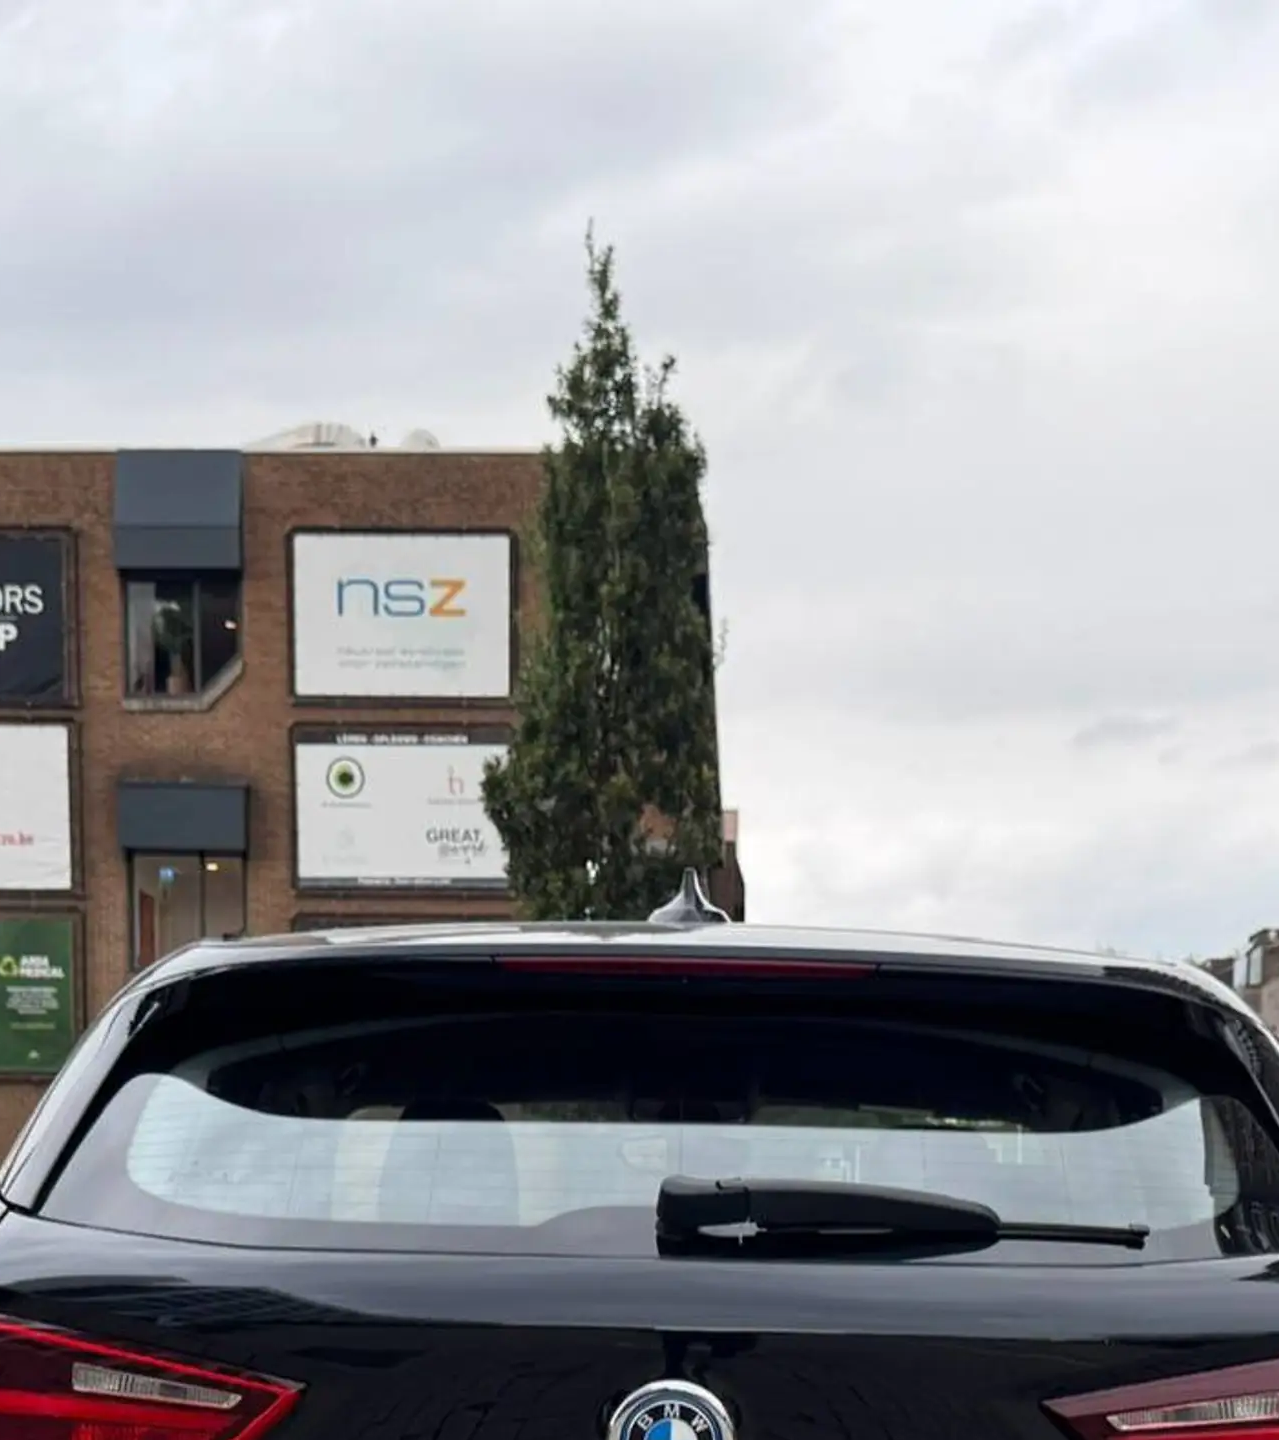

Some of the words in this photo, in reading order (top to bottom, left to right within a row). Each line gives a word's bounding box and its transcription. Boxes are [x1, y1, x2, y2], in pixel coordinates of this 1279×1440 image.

[336, 576, 467, 619] nsz
[425, 827, 482, 844] GREAT
[636, 1402, 710, 1434] BMW
